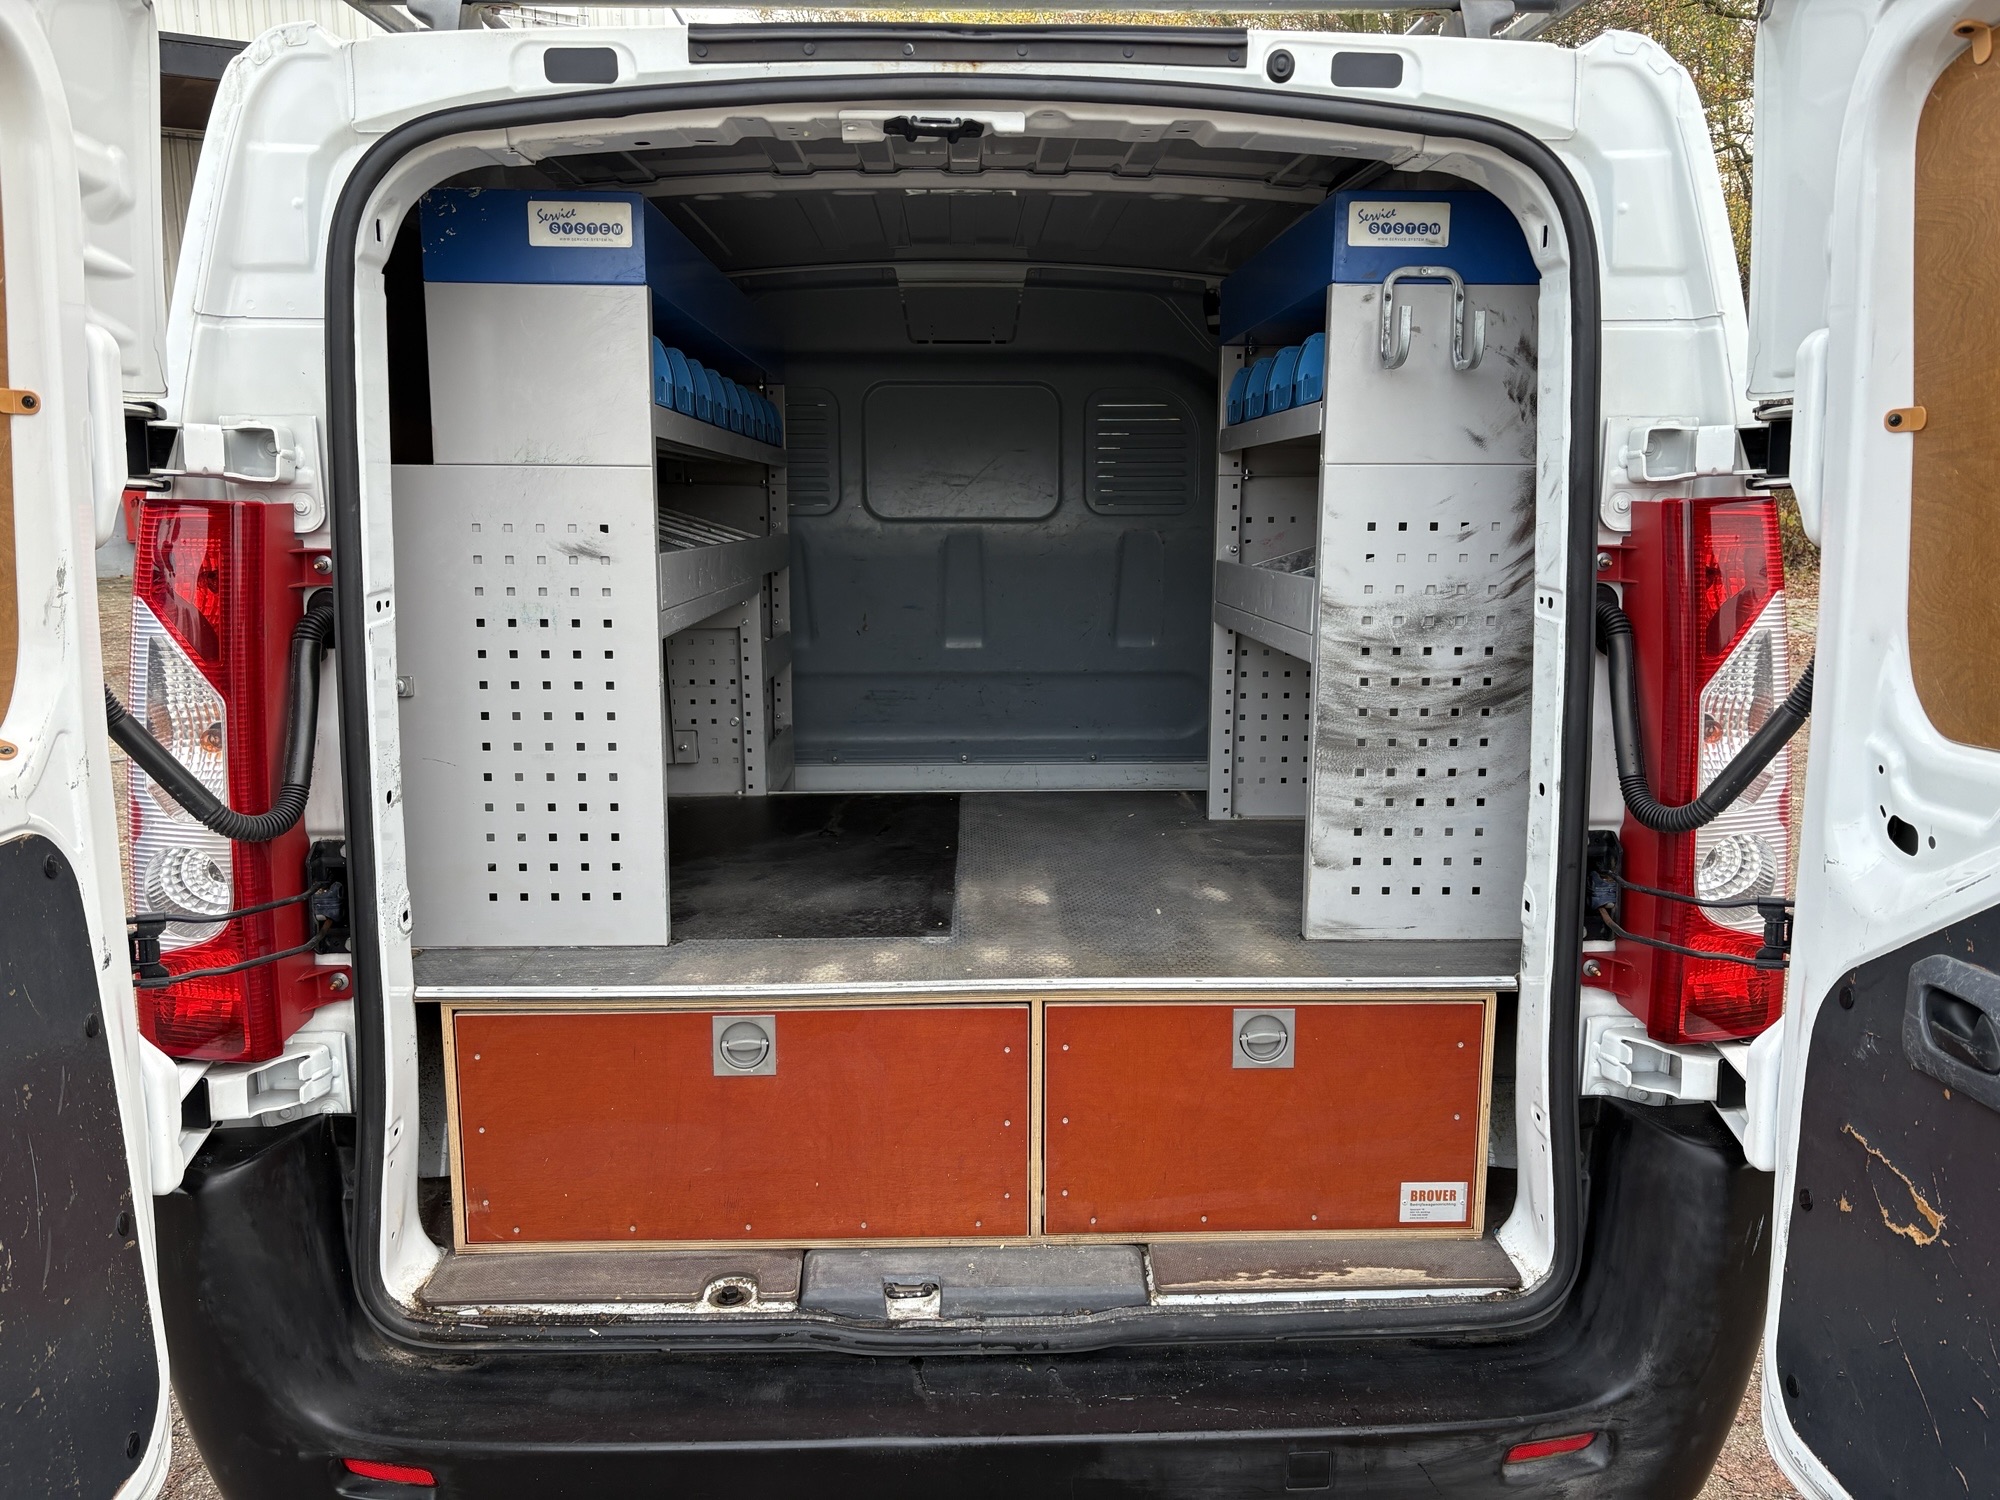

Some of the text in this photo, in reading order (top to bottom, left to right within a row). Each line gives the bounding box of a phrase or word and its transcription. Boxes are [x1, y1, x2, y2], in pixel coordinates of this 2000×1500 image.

[537, 208, 576, 224] Service
[1358, 208, 1396, 224] Service
[549, 222, 623, 235] SYSTEM
[1368, 222, 1441, 235] SYSTEM
[1410, 1189, 1457, 1202] BROVER
